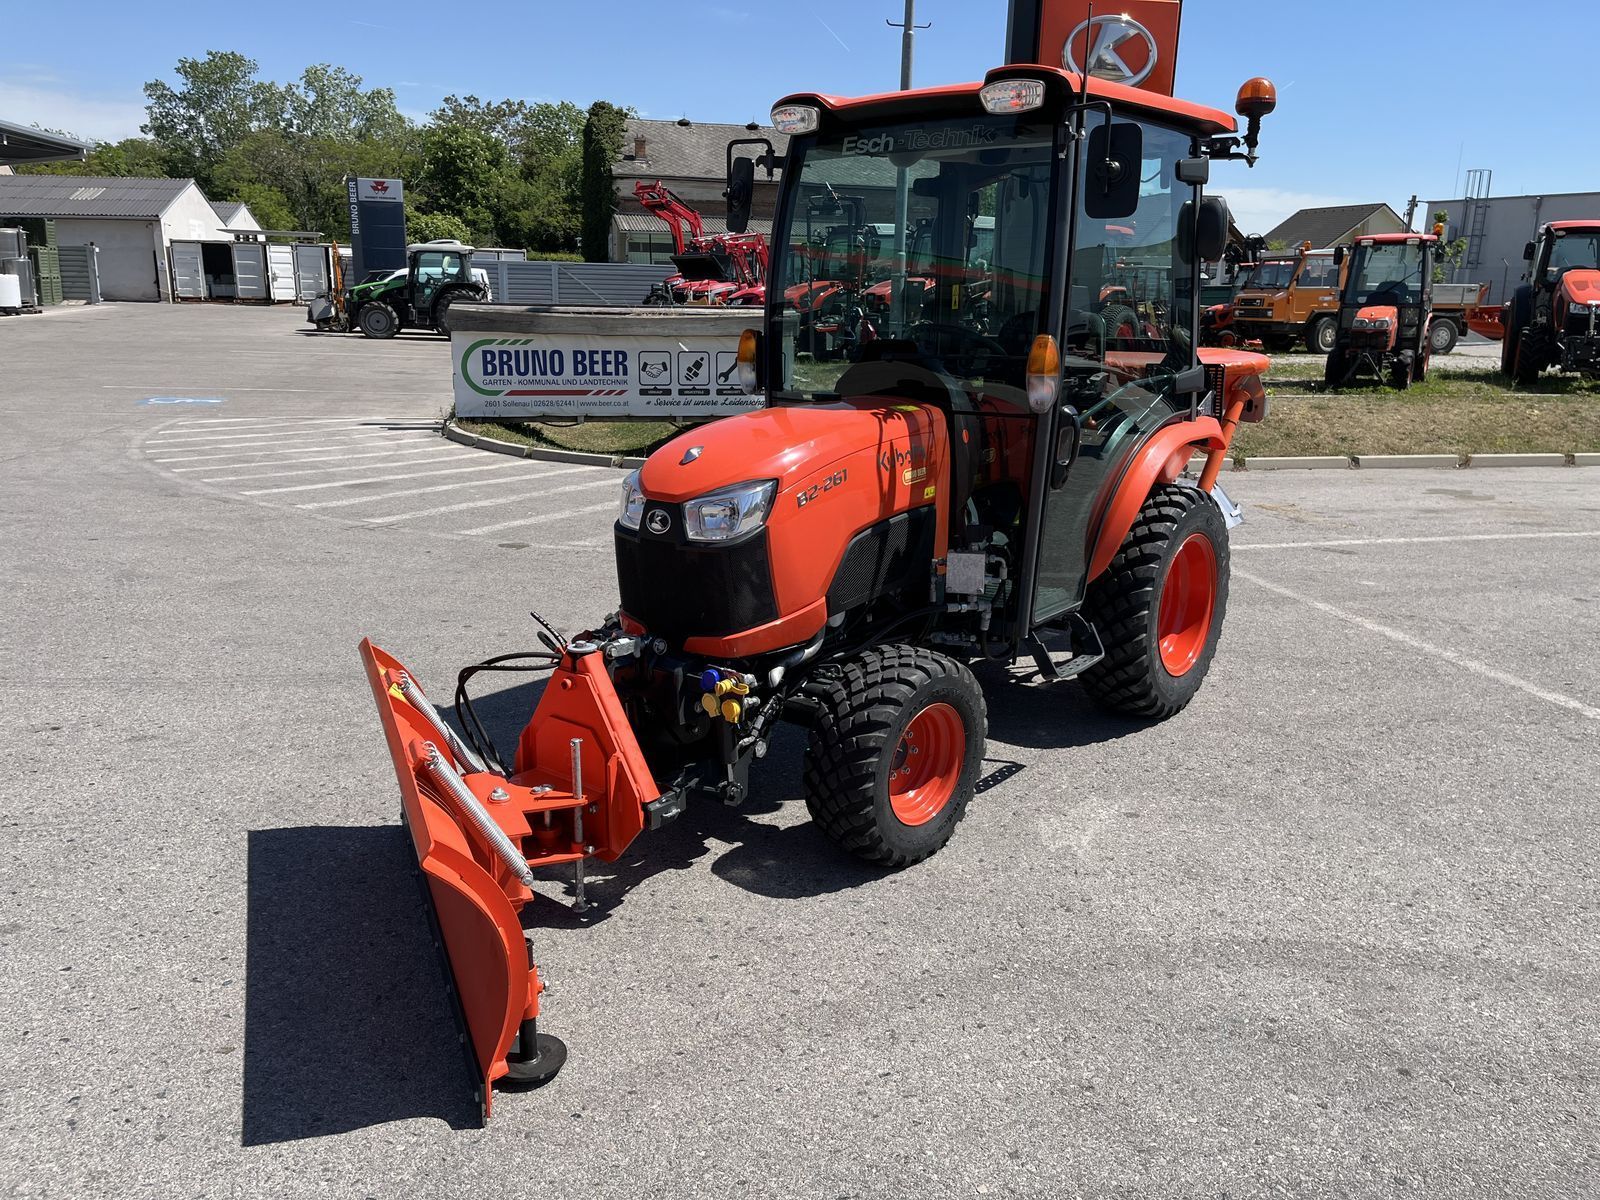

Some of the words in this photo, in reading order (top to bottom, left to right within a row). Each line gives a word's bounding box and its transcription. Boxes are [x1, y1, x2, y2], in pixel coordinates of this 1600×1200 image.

[348, 181, 357, 203] BEER
[351, 204, 360, 235] BRUNO
[481, 349, 565, 377] BRUNO
[572, 350, 629, 377] BEER
[482, 378, 512, 386] GARTEN
[517, 378, 560, 386] KOMMUNAL
[562, 378, 578, 386] UND
[579, 378, 629, 386] LANDTECHNIK
[653, 397, 679, 407] Service
[683, 398, 692, 407] ist
[693, 399, 719, 407] unsere
[720, 397, 766, 408] Leidenscha
[796, 468, 848, 509] B2-261
